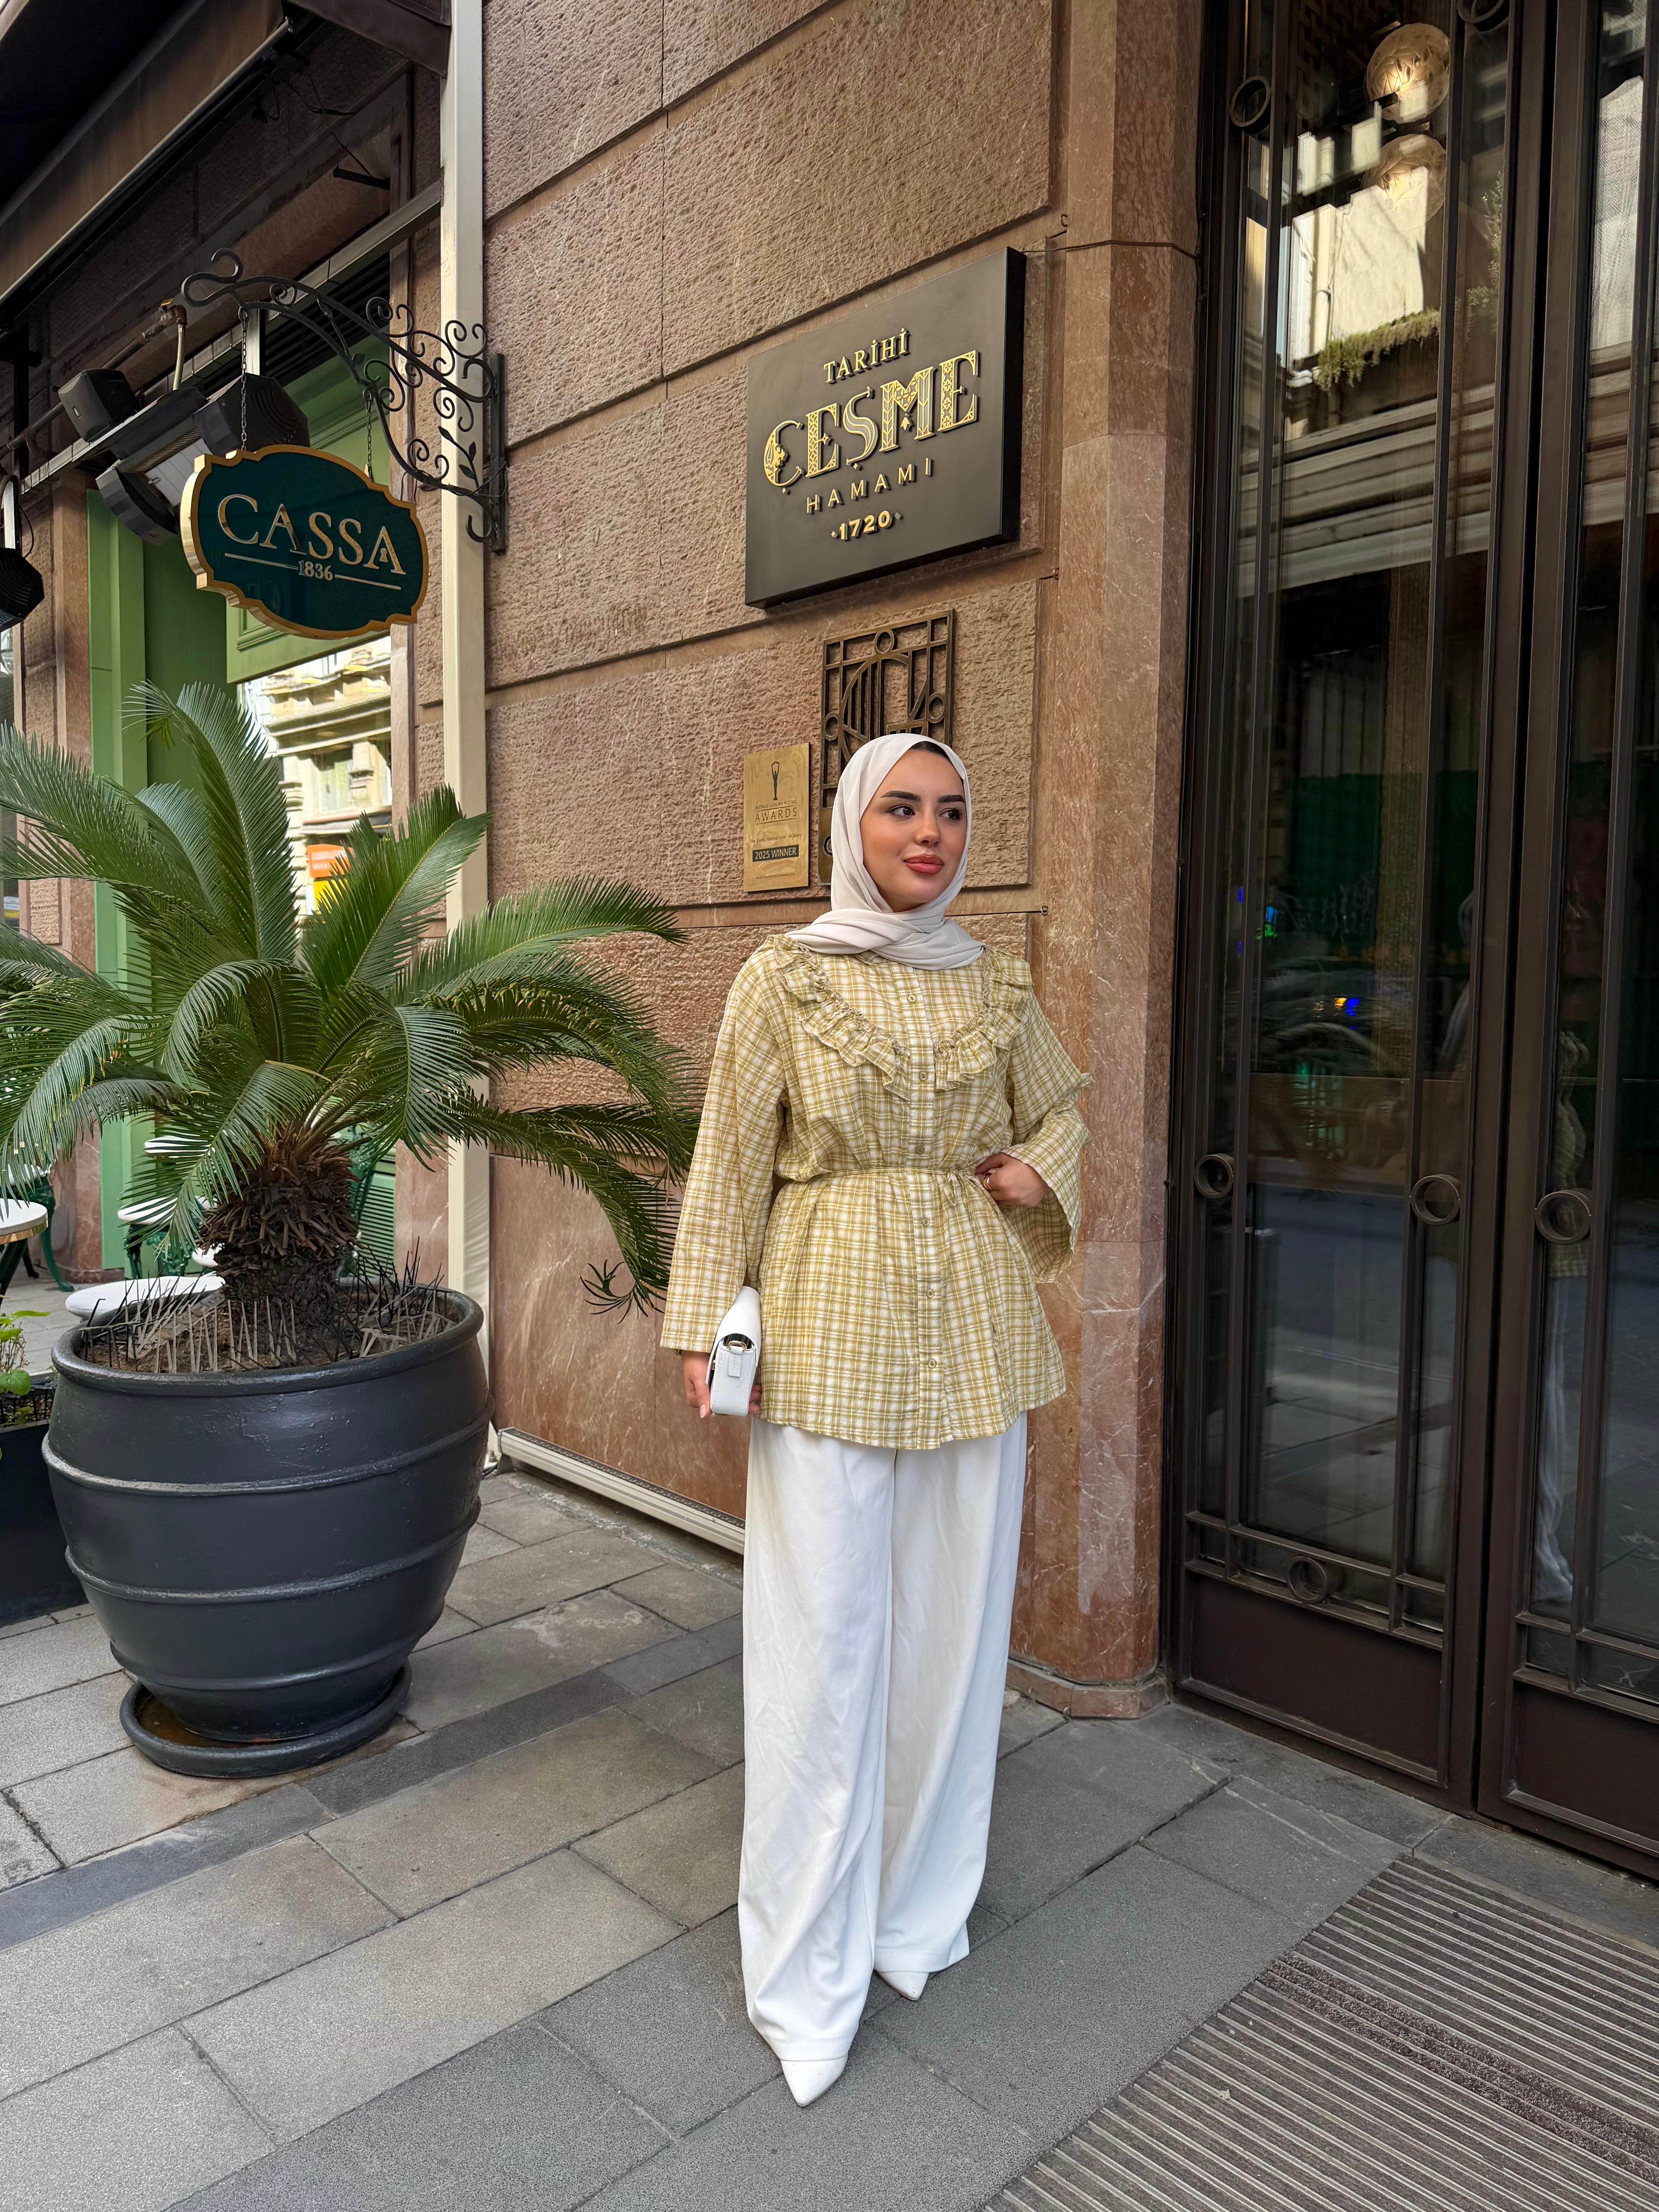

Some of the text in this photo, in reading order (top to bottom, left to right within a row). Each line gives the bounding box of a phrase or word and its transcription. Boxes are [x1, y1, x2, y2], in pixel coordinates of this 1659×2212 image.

[824, 328, 908, 383] TARİHİ
[764, 350, 977, 494] ÇEŞME
[807, 457, 930, 514] HAMAMI
[218, 494, 406, 575] CASSA
[298, 560, 333, 580] 1836
[755, 807, 797, 822] AWARDS
[755, 847, 797, 860] 2025 WINNER
